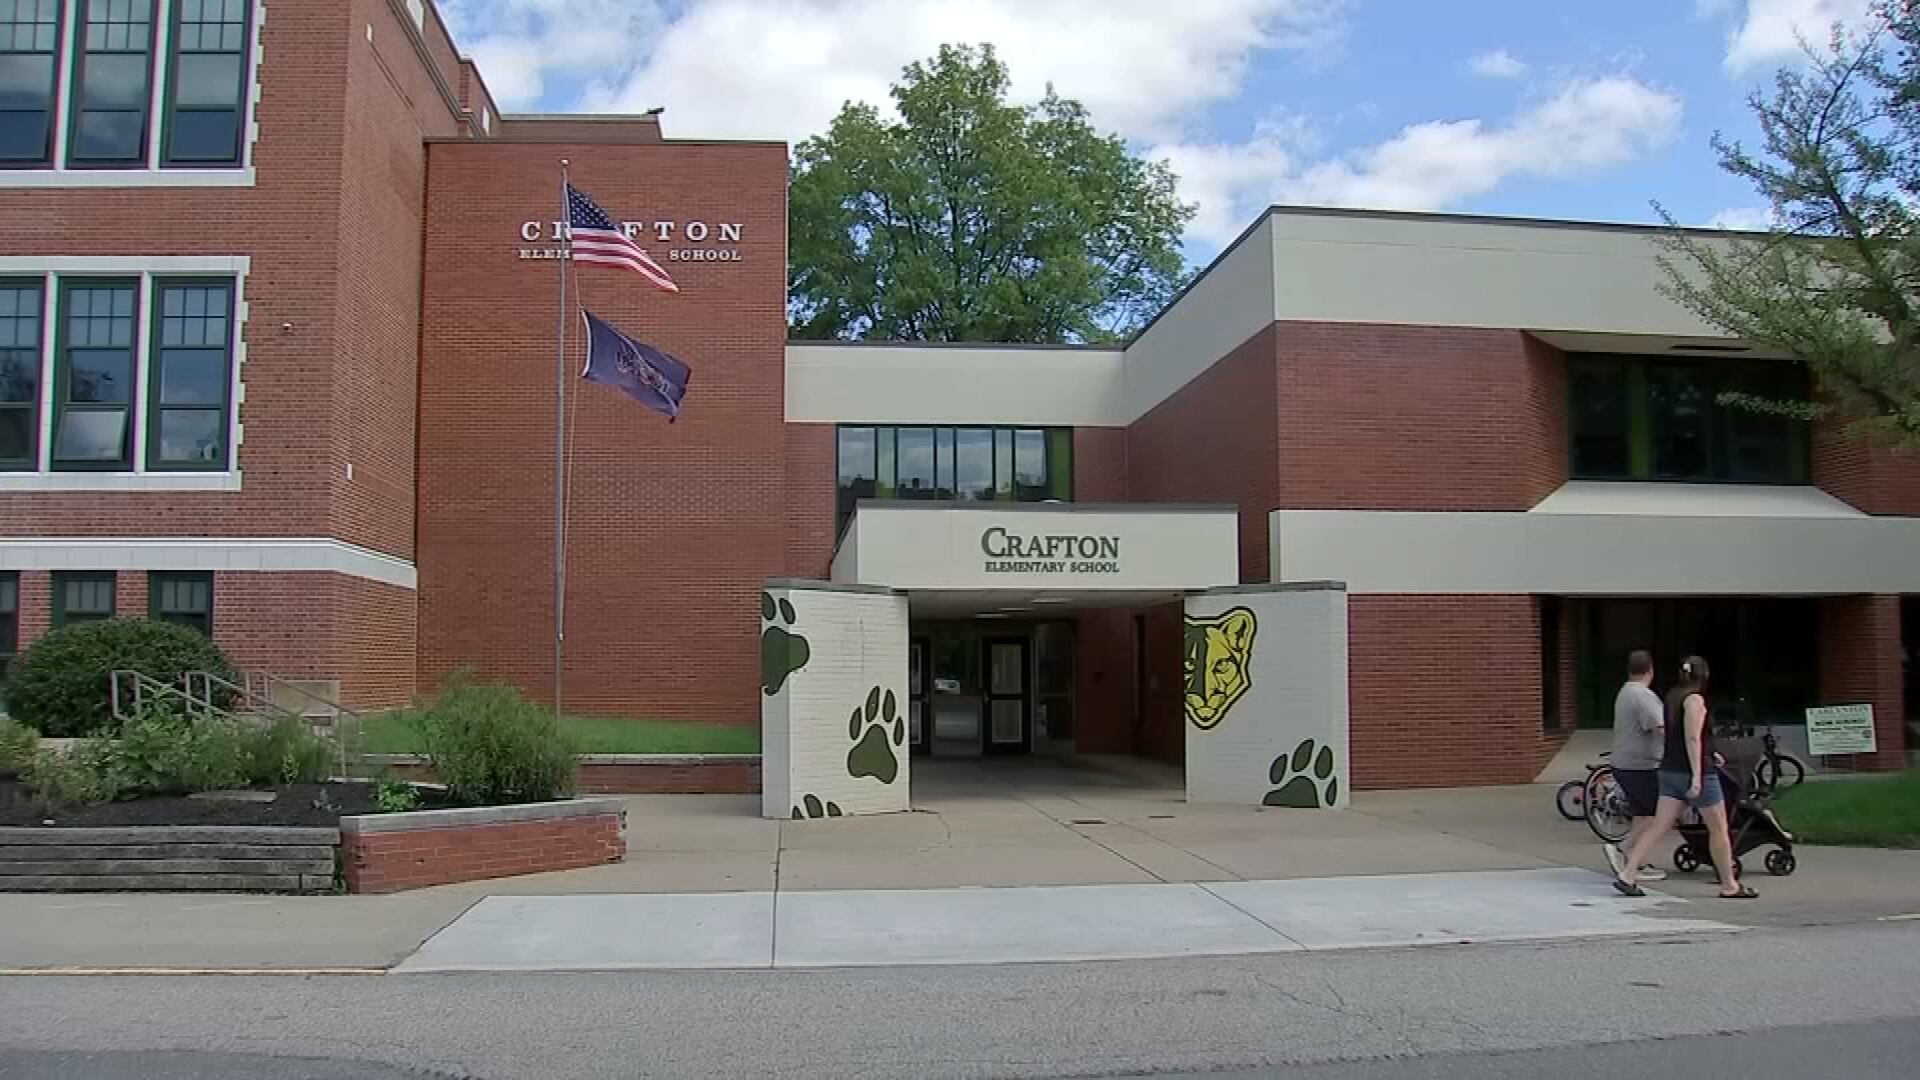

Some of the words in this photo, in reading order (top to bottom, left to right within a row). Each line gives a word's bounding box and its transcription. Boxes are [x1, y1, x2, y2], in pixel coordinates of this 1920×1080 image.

[521, 221, 744, 241] CRFTON
[669, 249, 742, 261] SCHOOL
[981, 527, 1120, 558] CRAFTON
[985, 561, 1066, 573] ELEMENTARY
[1070, 561, 1120, 573] SCHOOL
